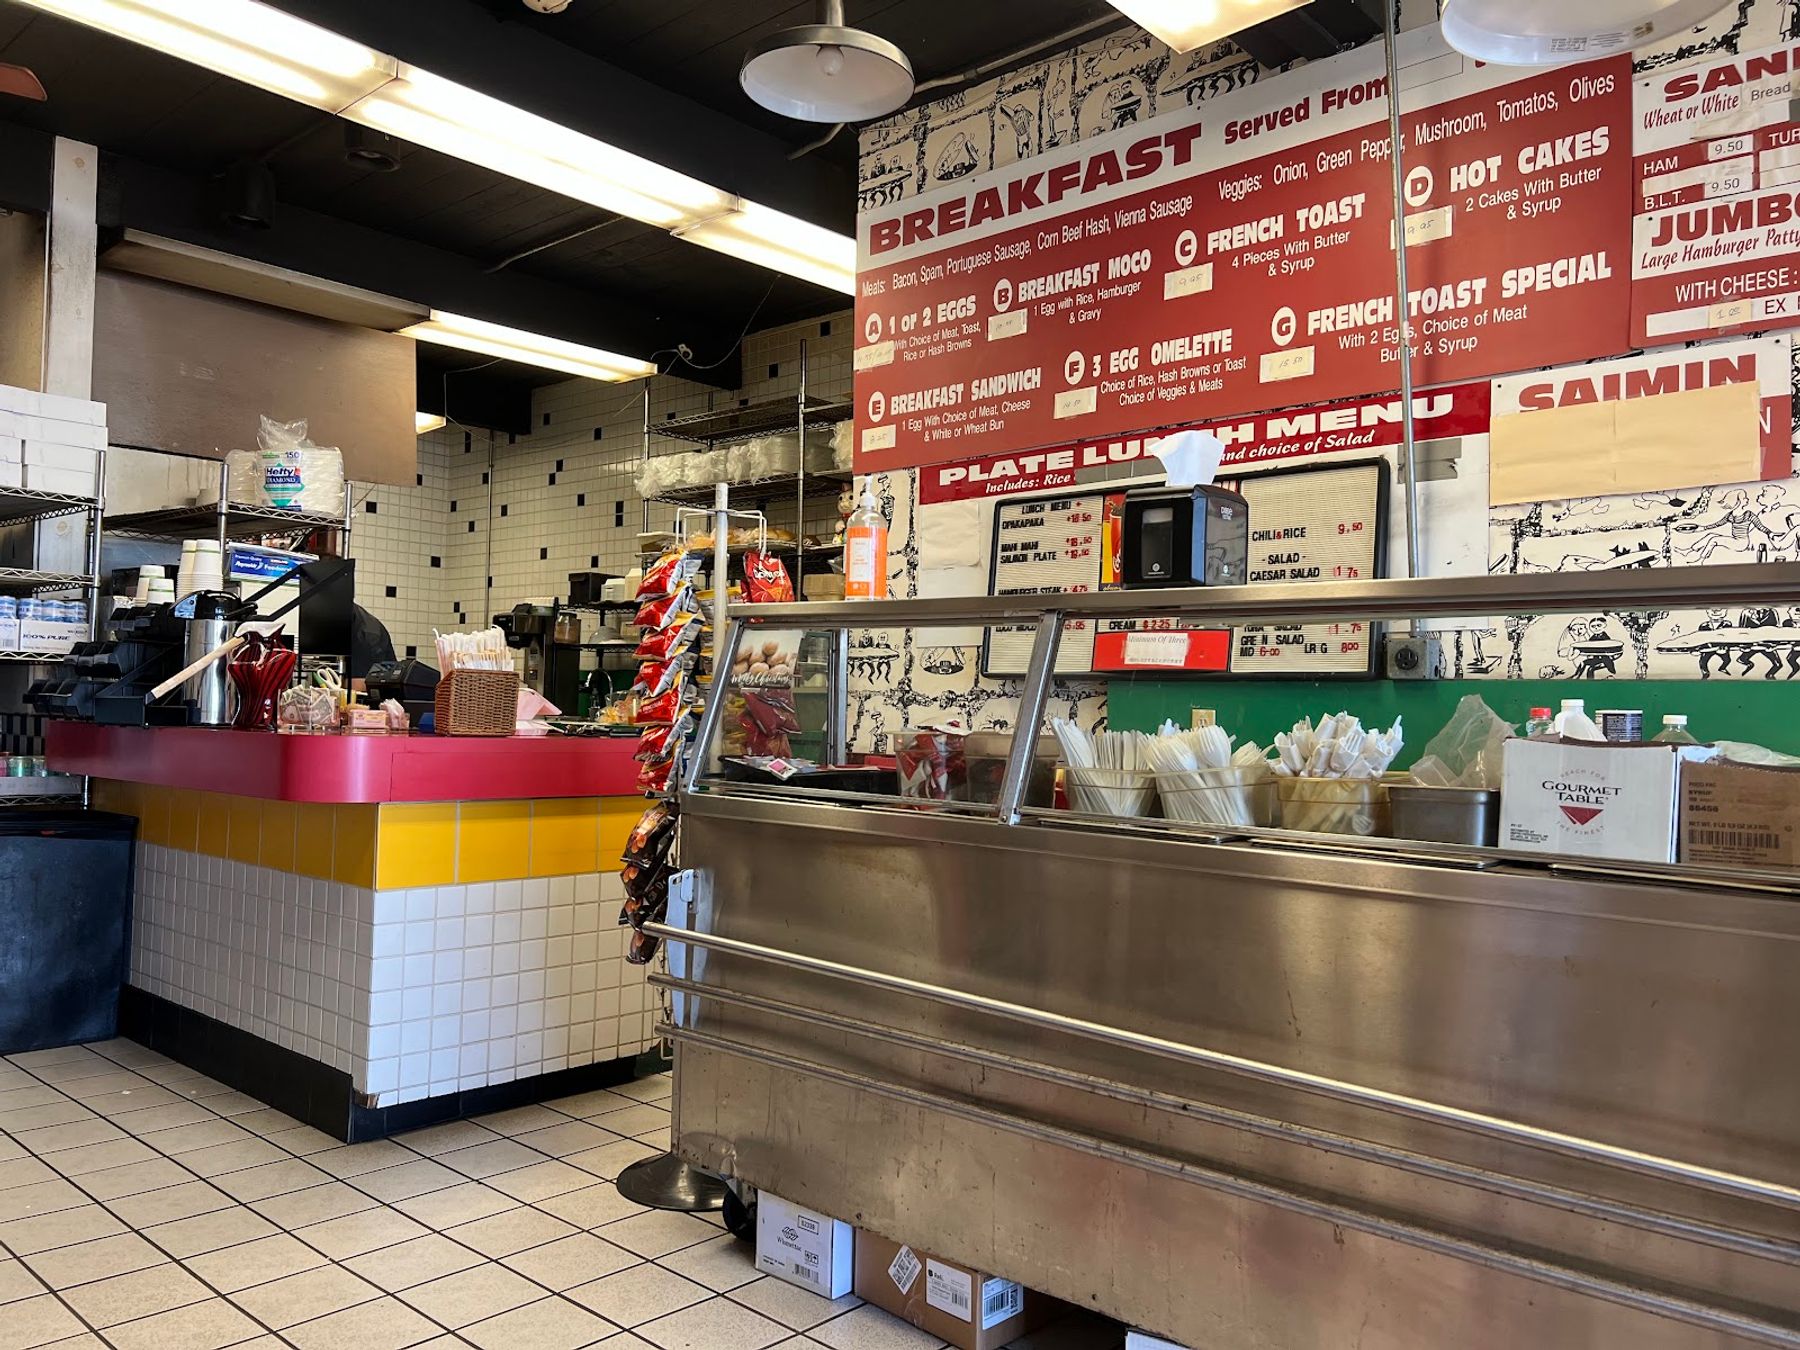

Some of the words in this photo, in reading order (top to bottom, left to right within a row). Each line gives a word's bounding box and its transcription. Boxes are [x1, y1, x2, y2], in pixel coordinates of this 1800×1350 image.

[1664, 47, 1800, 103] SAN
[1643, 108, 1683, 130] Wheat
[1686, 105, 1699, 119] or
[1702, 93, 1739, 116] White
[1751, 82, 1791, 102] Bread
[1450, 155, 1502, 193] HOT
[1517, 126, 1610, 175] CAKES
[1714, 140, 1743, 155] 9.50
[870, 122, 1202, 256] BREAKFAST
[1224, 97, 1310, 145] Served
[1321, 75, 1389, 115] From
[1643, 156, 1679, 176] HAM
[861, 280, 886, 299] Meats:
[892, 270, 918, 291] Bacon,
[920, 263, 944, 285] Spam,
[946, 251, 992, 276] Portuguese
[994, 238, 1032, 262] Sausage,
[1037, 229, 1059, 250] Corn
[1062, 221, 1084, 244] Beef
[1085, 214, 1111, 238] Hash,
[1114, 206, 1147, 230] Vienna
[1149, 195, 1193, 220] Sausage
[1218, 174, 1263, 202] Veggies:
[1273, 161, 1309, 186] Onion,
[1316, 148, 1352, 173] Green
[1360, 133, 1406, 162] Peppr,
[1415, 110, 1487, 146] Mushroom,
[1496, 90, 1559, 124] Tomatos,
[1569, 73, 1615, 103] Olives
[1465, 197, 1474, 212] 2
[1479, 188, 1519, 209] Cakes
[1524, 178, 1554, 197] With
[1559, 166, 1602, 189] Butter
[1644, 190, 1686, 211] B.L.T.
[1711, 177, 1740, 192] 9.50
[1207, 214, 1284, 255] FRENCH
[1296, 193, 1366, 232] TOAST
[1506, 205, 1517, 220] &
[1522, 196, 1562, 218] Syrup
[1232, 255, 1239, 269] 4
[1243, 247, 1280, 266] Pieces
[1284, 239, 1310, 257] With
[1314, 230, 1351, 250] Butter
[1641, 252, 1678, 270] Large
[1682, 238, 1759, 262] Hamburger
[1018, 262, 1100, 303] BREAKFAST
[1108, 248, 1152, 280] MOCO
[1268, 263, 1277, 277] &
[1281, 255, 1315, 276] Syrup
[1033, 304, 1038, 316] 1
[1041, 302, 1055, 317] Egg
[1058, 296, 1074, 311] with
[1076, 292, 1095, 306] Rice,
[1097, 280, 1142, 302] Hamburger
[1307, 295, 1393, 336] FRENCH
[1407, 277, 1487, 316] TOAST
[1501, 251, 1612, 298] SPECIAL
[1675, 279, 1717, 303] WITH
[1765, 297, 1786, 315] EX
[888, 315, 896, 335] 1
[901, 313, 917, 332] or
[922, 307, 932, 327] 2
[937, 295, 977, 323] EGGS
[1069, 311, 1076, 324] &
[1078, 307, 1102, 322] Gravy
[1338, 334, 1365, 350] With
[1370, 330, 1378, 344] 2
[1383, 326, 1418, 344] Egs,
[1423, 315, 1468, 335] Choice
[1474, 310, 1488, 327] of
[1493, 304, 1528, 323] Meat
[903, 349, 918, 362] Rice
[919, 347, 927, 358] or
[928, 342, 945, 357] Hash
[947, 338, 972, 354] Browns
[909, 333, 931, 348] Choice
[933, 330, 940, 342] of
[941, 325, 960, 340] Meat,
[962, 320, 981, 335] Toast,
[1424, 341, 1433, 356] &
[1438, 336, 1478, 355] Syrup
[1092, 355, 1102, 378] 3
[1110, 347, 1139, 374] EGG
[1151, 328, 1233, 366] OMELETTE
[1100, 378, 1126, 394] Choice
[1127, 376, 1136, 389] of
[1137, 372, 1156, 387] Rice,
[1157, 366, 1178, 384] Hash
[1180, 362, 1211, 380] Browns
[1212, 361, 1222, 374] or
[1224, 356, 1247, 373] Toast
[1519, 354, 1756, 412] SAIMIN
[890, 383, 964, 416] BREAKFAST
[971, 367, 1042, 401] SANDWICH
[1119, 390, 1145, 406] Choice
[1147, 387, 1156, 402] of
[1157, 383, 1187, 403] Veggies
[1189, 381, 1196, 394] &
[1198, 377, 1223, 393] Meats
[908, 419, 922, 432] Egg
[924, 414, 940, 428] With
[942, 409, 967, 424] Choice
[969, 407, 977, 419] of
[1001, 399, 1031, 413] Cheese
[923, 430, 930, 442] &
[932, 426, 952, 440] White
[954, 426, 962, 438] or
[964, 421, 988, 436] Wheat
[989, 418, 1004, 431] Bun
[939, 450, 1074, 486] PLATE
[1266, 393, 1454, 440] MENU
[266, 467, 294, 477] Hefty
[985, 477, 1040, 494] Includes:
[1043, 473, 1071, 486] Rice
[1221, 446, 1246, 462] nd
[1249, 440, 1300, 459] choice
[1304, 436, 1322, 453] of
[1325, 429, 1375, 448] Salad
[1250, 569, 1286, 581] CAESAR
[1290, 567, 1320, 580] SALAD
[1109, 621, 1136, 630] CREAM
[1276, 634, 1304, 645] SALAD
[1542, 780, 1622, 796] GOURMET
[1555, 791, 1605, 804] TABLE
